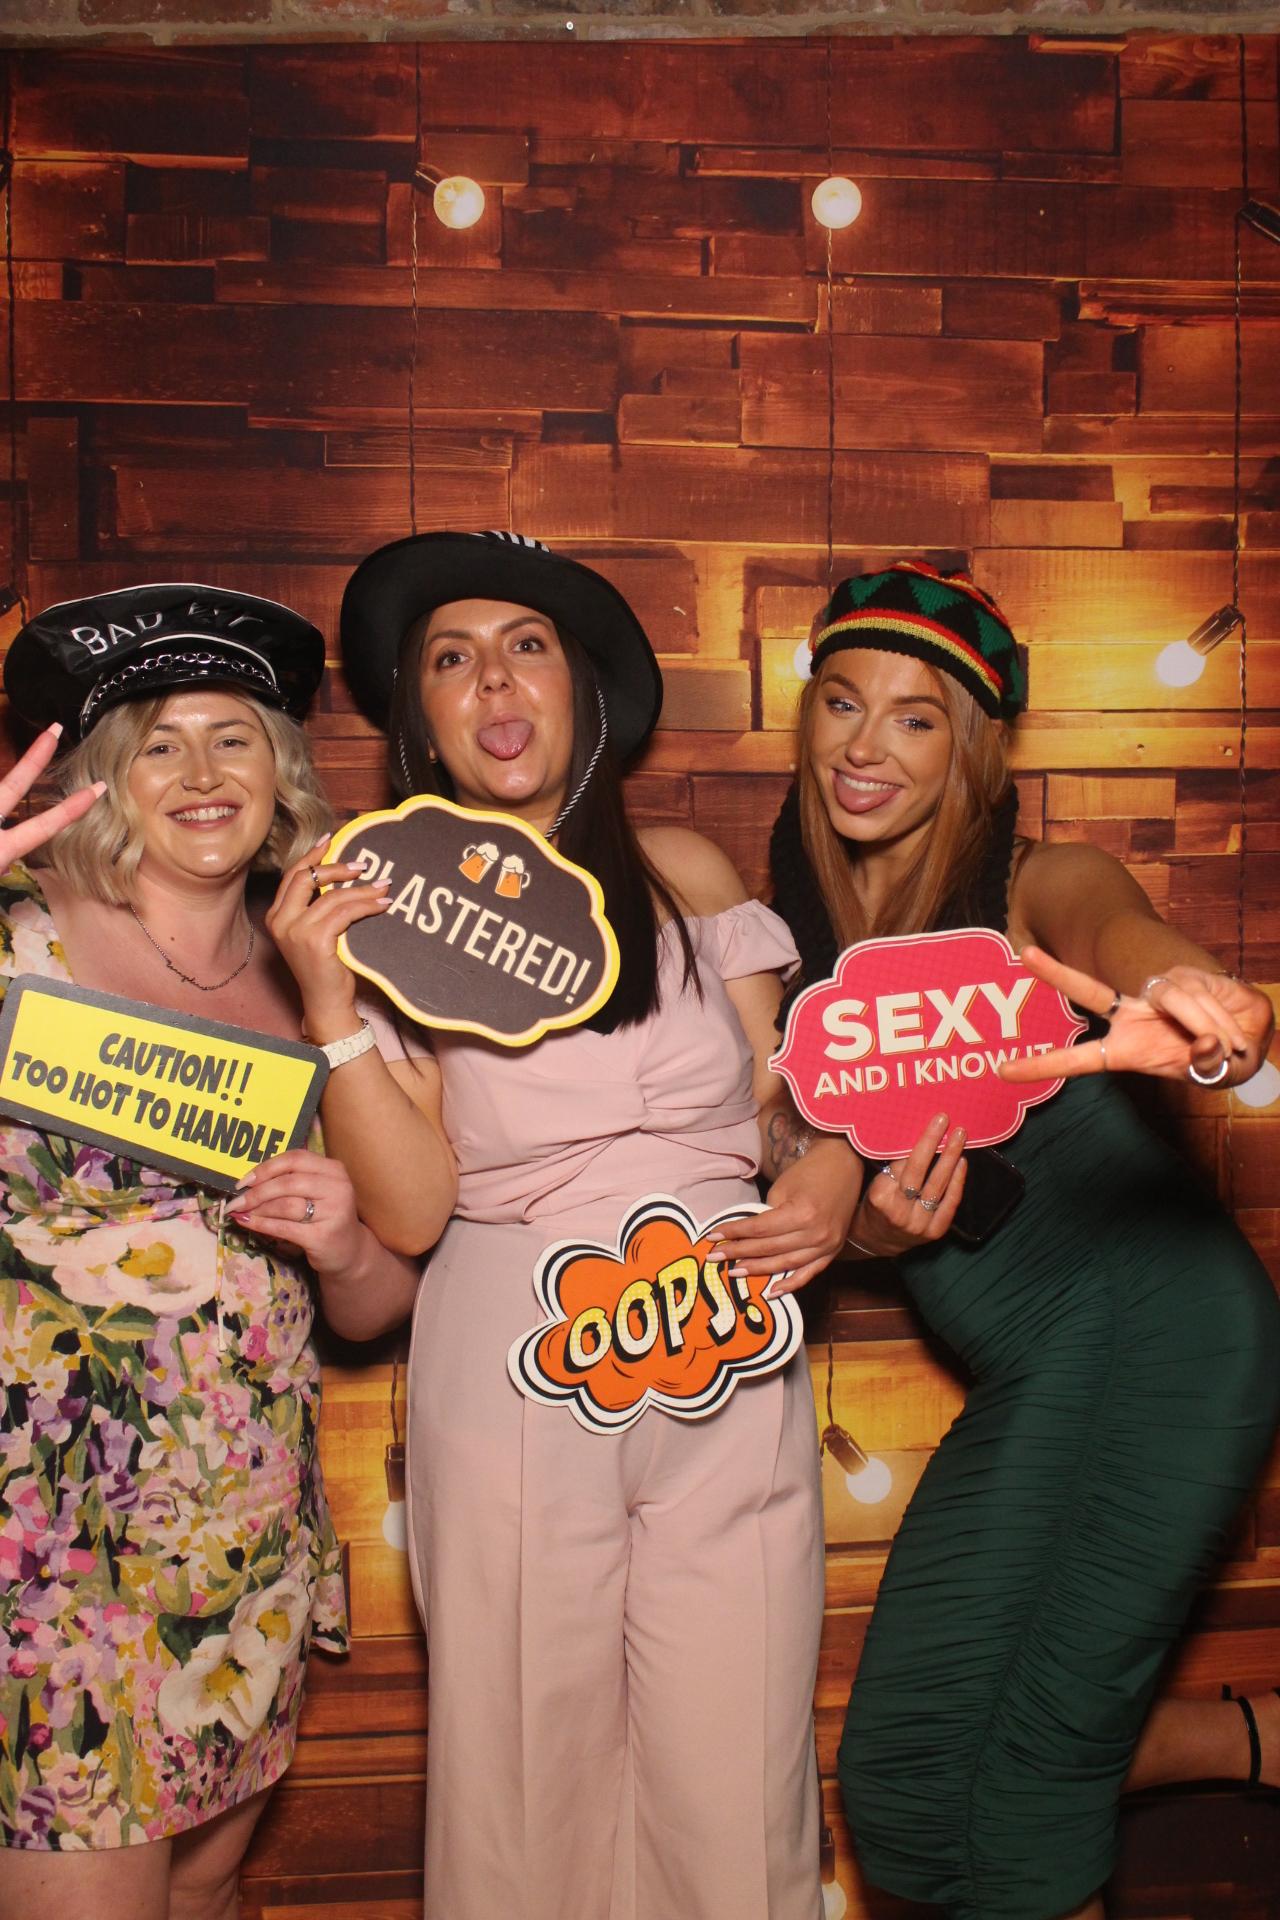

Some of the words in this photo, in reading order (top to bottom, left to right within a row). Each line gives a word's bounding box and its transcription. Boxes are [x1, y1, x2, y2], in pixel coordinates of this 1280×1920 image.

[71, 612, 163, 655] BAD
[821, 976, 1037, 1063] SEXY
[12, 1051, 69, 1094] TOO
[69, 1070, 133, 1116] HOT
[134, 1089, 171, 1130] TO
[171, 1102, 286, 1164] HANDLE
[99, 1032, 253, 1107] CAUTION!!
[813, 1065, 889, 1099] AND
[898, 1062, 907, 1088] I
[914, 1047, 1020, 1085] KNOW
[563, 1239, 766, 1373] OOPS!
